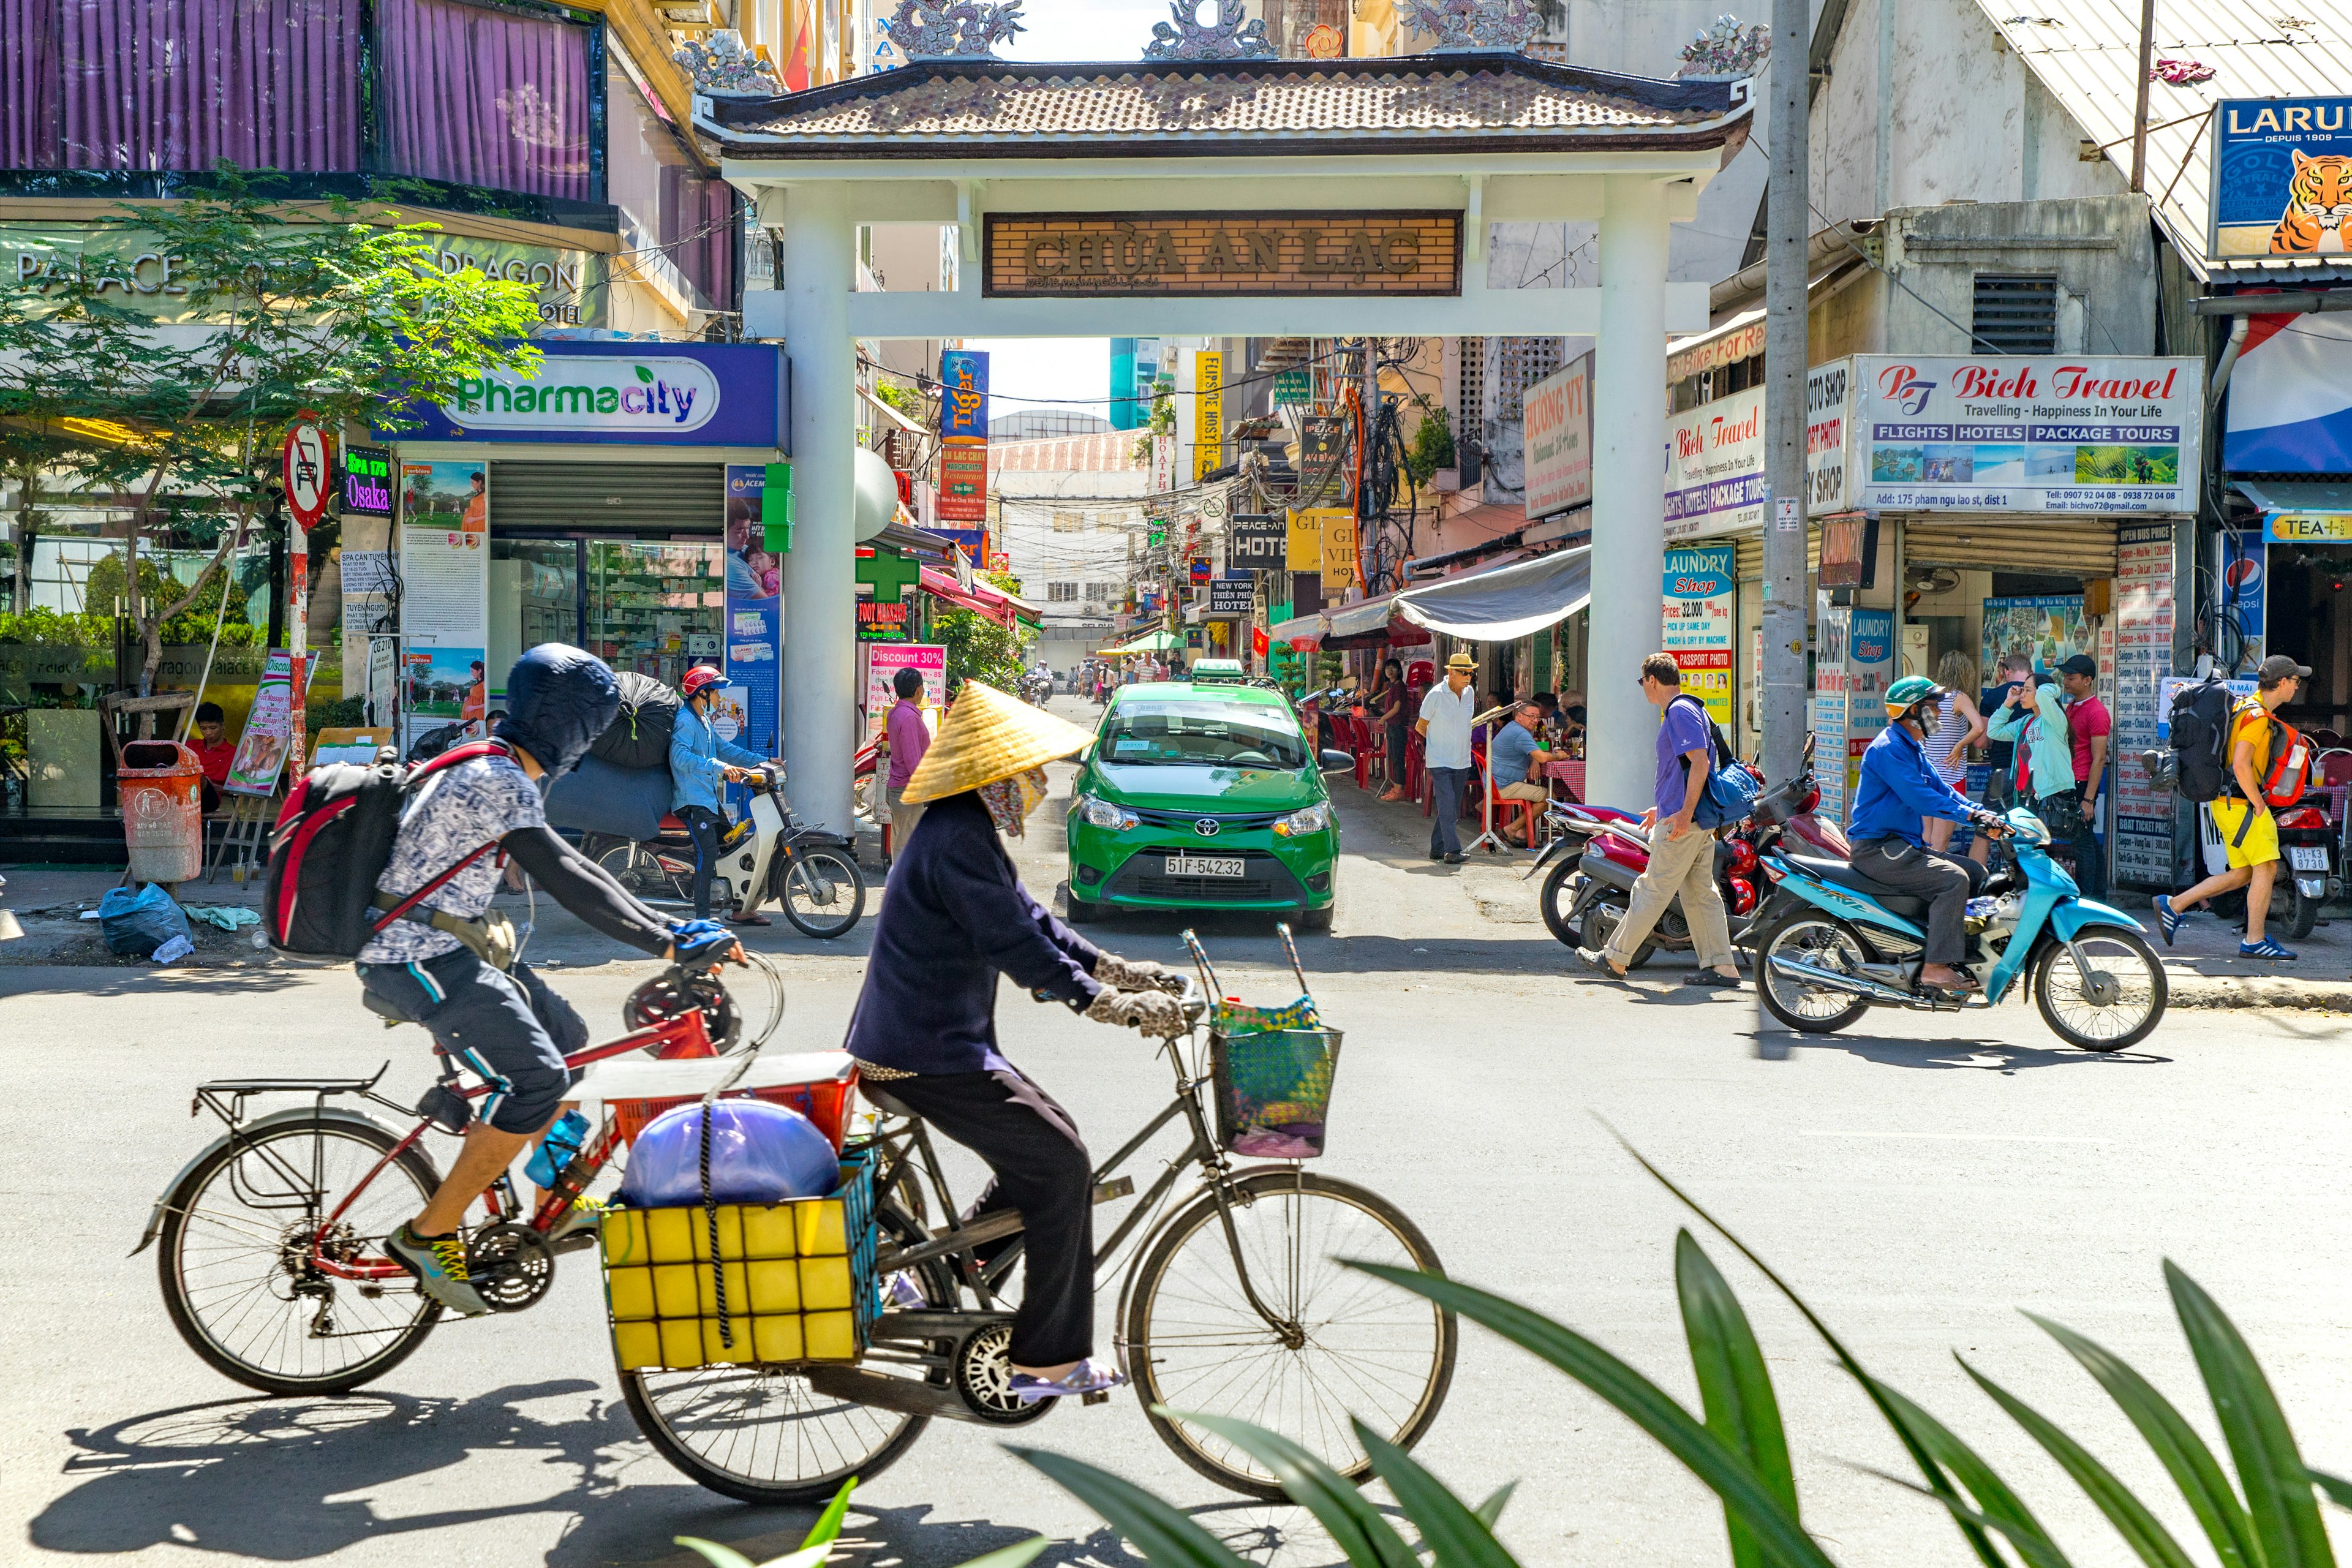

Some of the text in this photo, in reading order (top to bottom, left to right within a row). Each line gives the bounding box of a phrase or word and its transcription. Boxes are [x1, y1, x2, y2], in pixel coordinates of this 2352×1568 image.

[2228, 106, 2352, 134] LARU
[2265, 134, 2302, 143] DEPUIS
[1024, 221, 1419, 284] CHÙA AN LẠC
[439, 249, 578, 294] DRAGON
[1684, 347, 1711, 374] Bike
[1717, 336, 1741, 361] For
[1825, 368, 1846, 409] SHOP
[1951, 366, 2178, 399] Bich Travel
[458, 374, 697, 423] Pharmacity
[951, 368, 981, 430] Tiger
[1204, 357, 1219, 456] FLIPSIDE HOSTEL
[1526, 374, 1584, 440] HƯƠNG VY
[1964, 404, 2162, 419] Travelling Happiness In Your Life
[1676, 405, 1758, 459] Bich Travel
[1820, 417, 1841, 451] PHOTO
[1879, 426, 2022, 439] FLIGHTS HOTELS
[2035, 428, 2173, 440] PACKAGE TOURS
[943, 451, 986, 461] AN LAC CHAY
[347, 453, 387, 477] SPA 173
[946, 462, 982, 471] MARGHERITA
[1705, 461, 1727, 476] Happiness
[1728, 458, 1733, 470] In
[1734, 458, 1746, 470] Your
[944, 471, 984, 480] Restaurant
[348, 474, 390, 511] Osaka
[1816, 466, 1842, 504] SHOP
[1684, 476, 1765, 514] HOTELS PACKAGE TOURS
[1877, 494, 2007, 507] Add: 175 pham ngu lao st, dist 1
[2046, 491, 2062, 499] Tell:
[2106, 491, 2116, 500] 08
[2154, 492, 2164, 500] 04
[2165, 492, 2176, 500] 08
[2070, 502, 2147, 511] bichvo72@gmail.com
[2120, 526, 2169, 541] OPEN BUS PRICE
[1825, 522, 1861, 565] LAUNDRY
[2119, 545, 2170, 561] Saigon 120.000
[1663, 554, 1728, 574] LAUNDRY
[2119, 565, 2133, 578] Saigon
[2137, 565, 2143, 575] Da
[2154, 563, 2170, 573] 270.000
[1673, 577, 1716, 596] Shop
[1212, 590, 1235, 600] THIÊN
[859, 603, 907, 623] FOOT MASSAGE
[1213, 601, 1255, 611] HOTEL
[1662, 601, 1728, 619] Prices: 32.000 kg
[1667, 622, 1711, 631] PICK UP SAME DAY
[1853, 618, 1890, 637] LAUNDRY
[2155, 615, 2170, 625] 490.000
[1667, 635, 1727, 645] WASH DRY BY MACHINE
[2101, 630, 2113, 644] TAXI
[2119, 632, 2170, 646] Saigon 730.000
[373, 638, 392, 654] CG 210
[1858, 640, 1883, 661] Shop
[872, 650, 942, 665] Discount 30%
[1679, 653, 1728, 666] PASSPORT PHOTO
[2119, 650, 2133, 662] Saigon
[2155, 649, 2170, 660] 140.000
[1197, 662, 1237, 672] TAXI
[257, 693, 285, 703] Foot Massage
[1706, 697, 1728, 706] MINUTES
[252, 714, 262, 724] Body
[2119, 718, 2132, 730] Saigon
[2119, 735, 2133, 747] Saigon
[2119, 802, 2151, 816] Saigon Bangkok
[2119, 818, 2155, 832] BOAT TICKET
[2119, 835, 2132, 848] Saigon
[2155, 839, 2170, 851] 300.000
[2296, 849, 2322, 858] 51-K3
[1167, 858, 1242, 876] 51F-542.32
[2297, 859, 2324, 869] 8730
